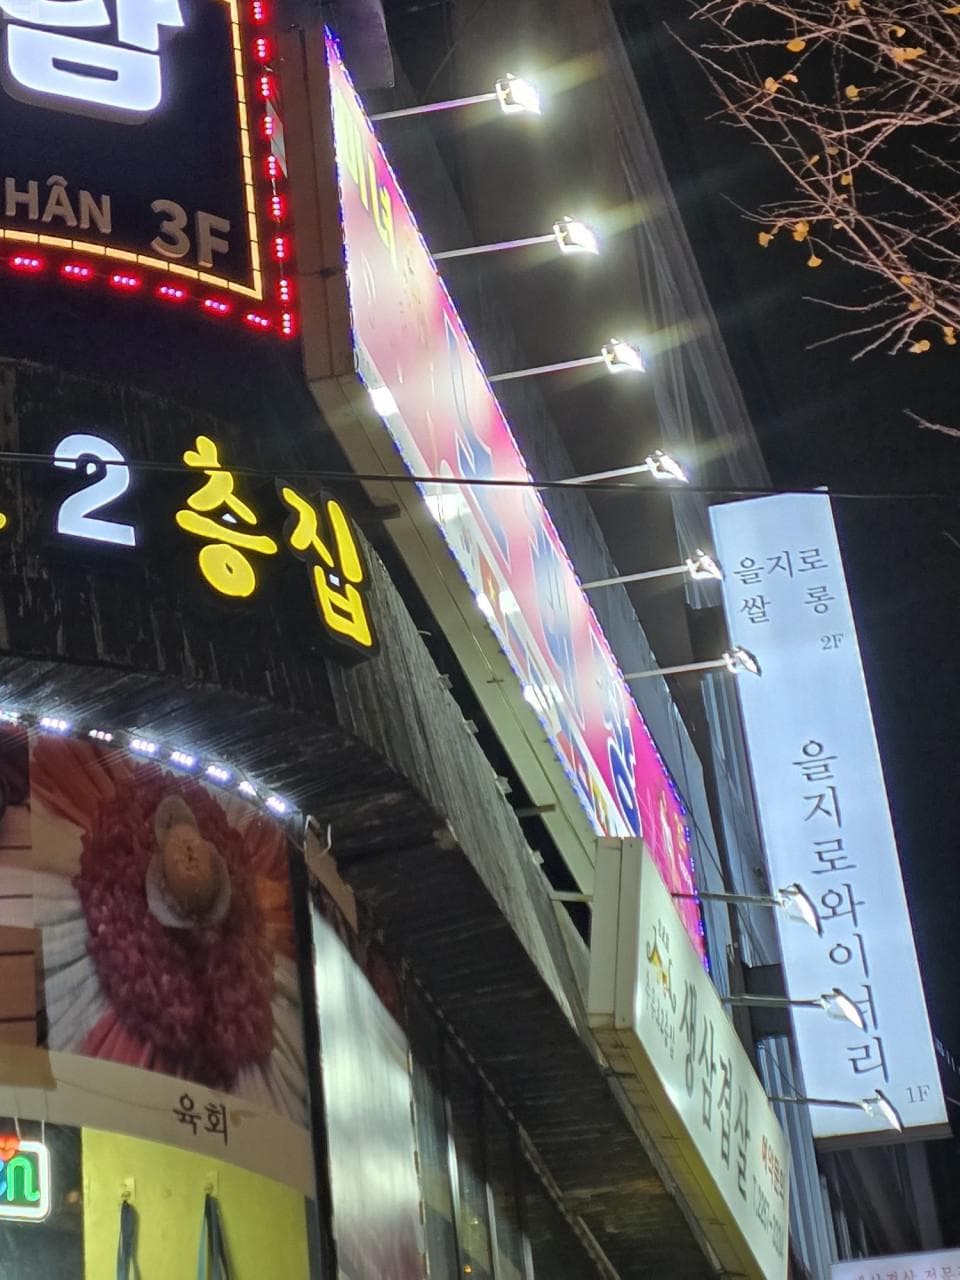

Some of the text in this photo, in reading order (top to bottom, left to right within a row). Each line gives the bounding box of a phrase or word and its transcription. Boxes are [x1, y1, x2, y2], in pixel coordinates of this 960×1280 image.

[149, 199, 232, 268] 3F
[733, 547, 830, 585] 을지로
[820, 633, 845, 651] 2F
[678, 978, 752, 1203] 생삼겹살
[906, 1084, 932, 1105] 1F
[172, 1092, 231, 1147] 육회
